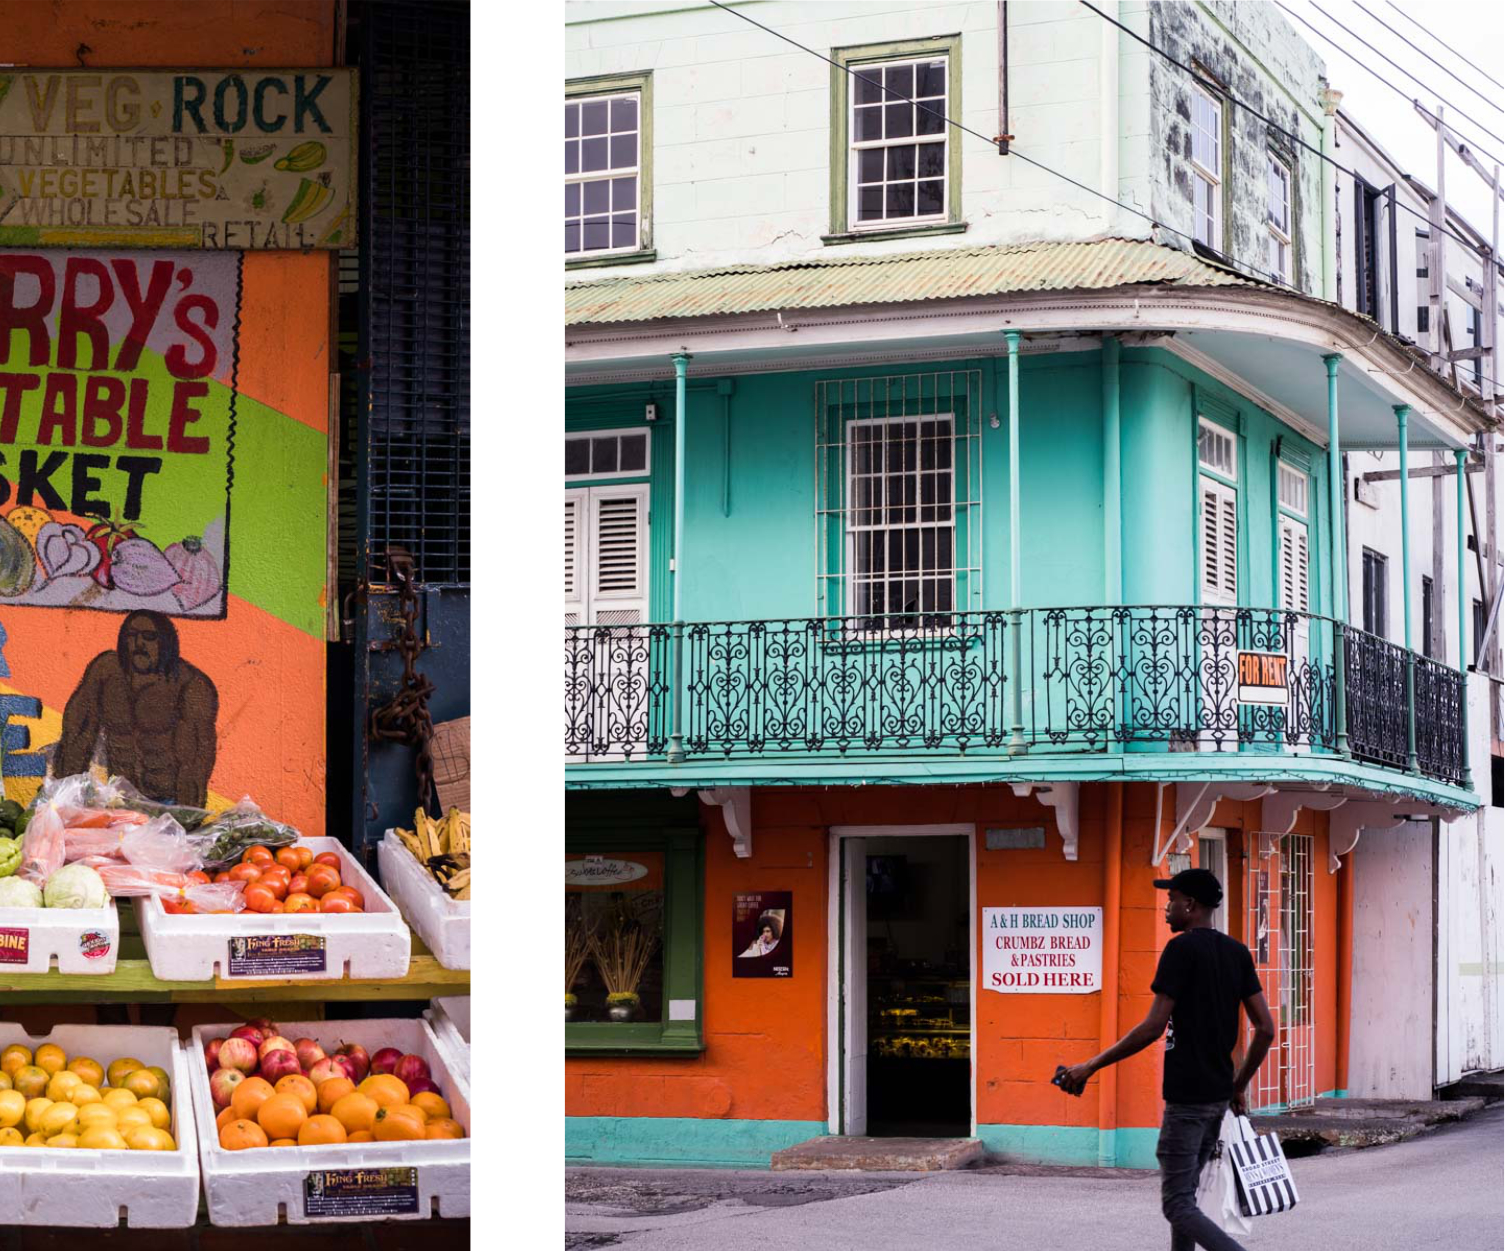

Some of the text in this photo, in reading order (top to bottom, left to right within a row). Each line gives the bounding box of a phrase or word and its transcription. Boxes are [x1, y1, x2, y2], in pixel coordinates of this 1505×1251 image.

[23, 74, 334, 134] VEG ROCK
[17, 199, 199, 226] WHOLESALE
[1239, 654, 1286, 686] FOR RENT
[990, 913, 1096, 928] A & H BREAD SHOP
[996, 936, 1091, 950] CRUMBZ BREAD
[992, 972, 1094, 987] SOLD HERE
[1261, 1158, 1280, 1167] STREET
[325, 1171, 388, 1187] KING FRESH
